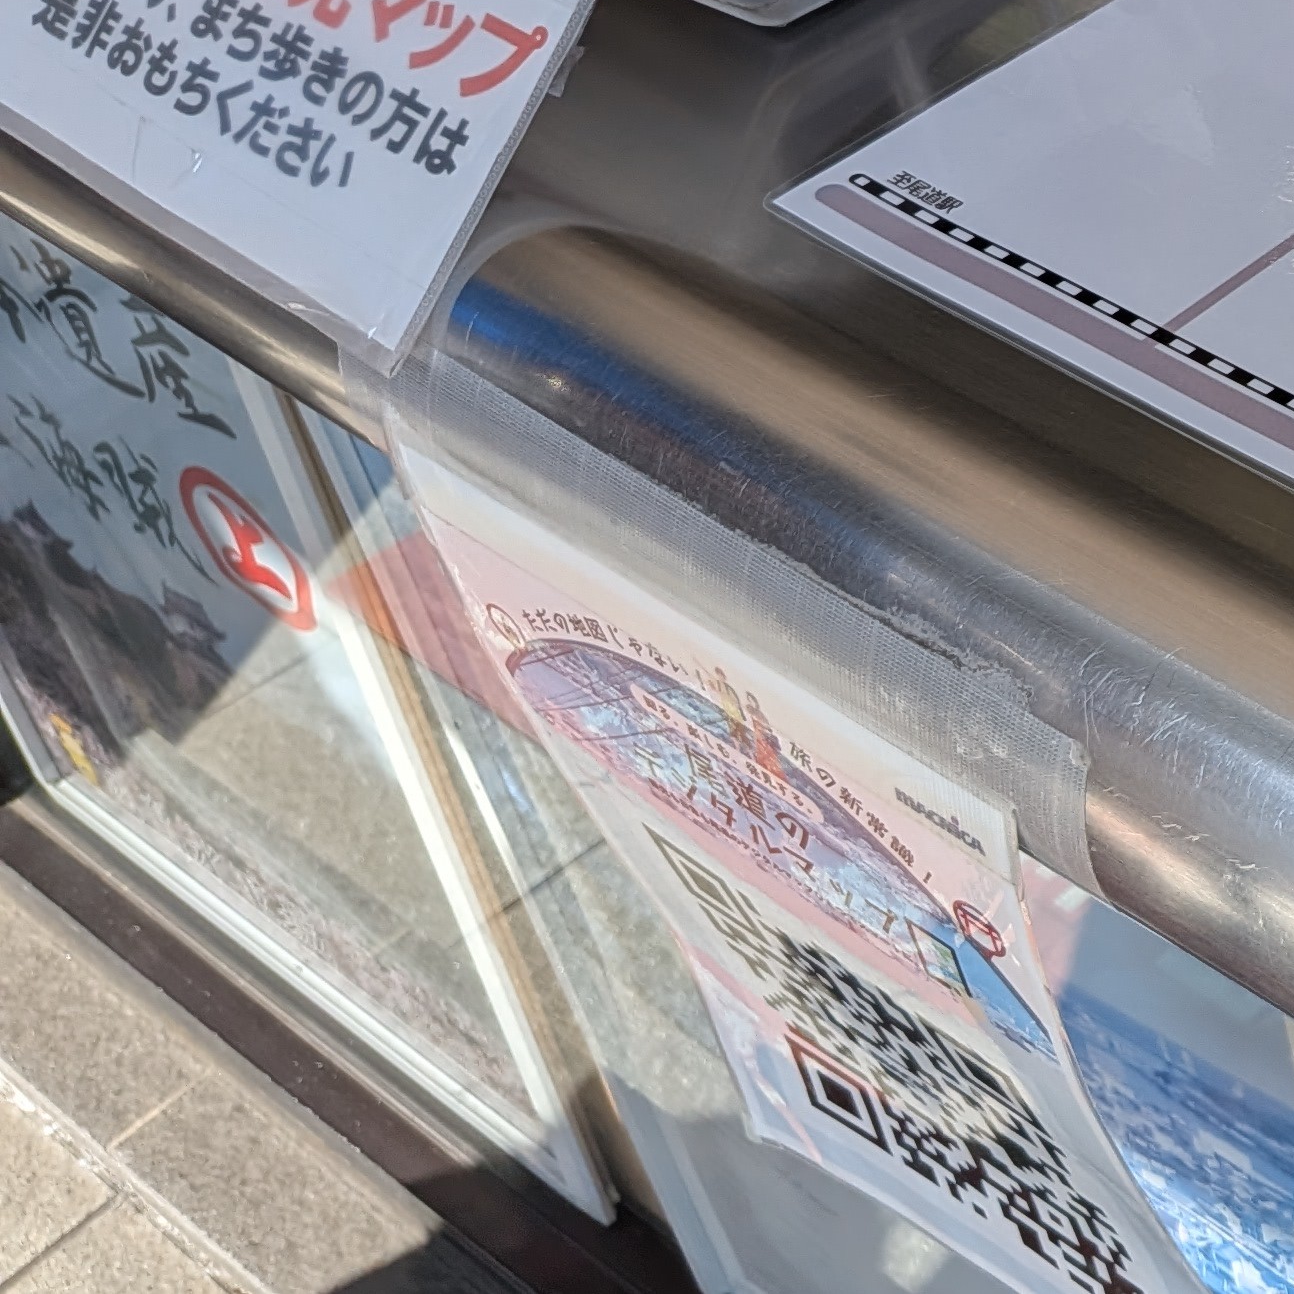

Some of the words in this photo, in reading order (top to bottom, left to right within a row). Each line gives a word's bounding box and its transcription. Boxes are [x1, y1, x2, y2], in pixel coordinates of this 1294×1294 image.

[887, 170, 964, 214] 至尾道駅
[633, 742, 899, 936] デジタルマップ
[684, 743, 811, 851] 尾道の
